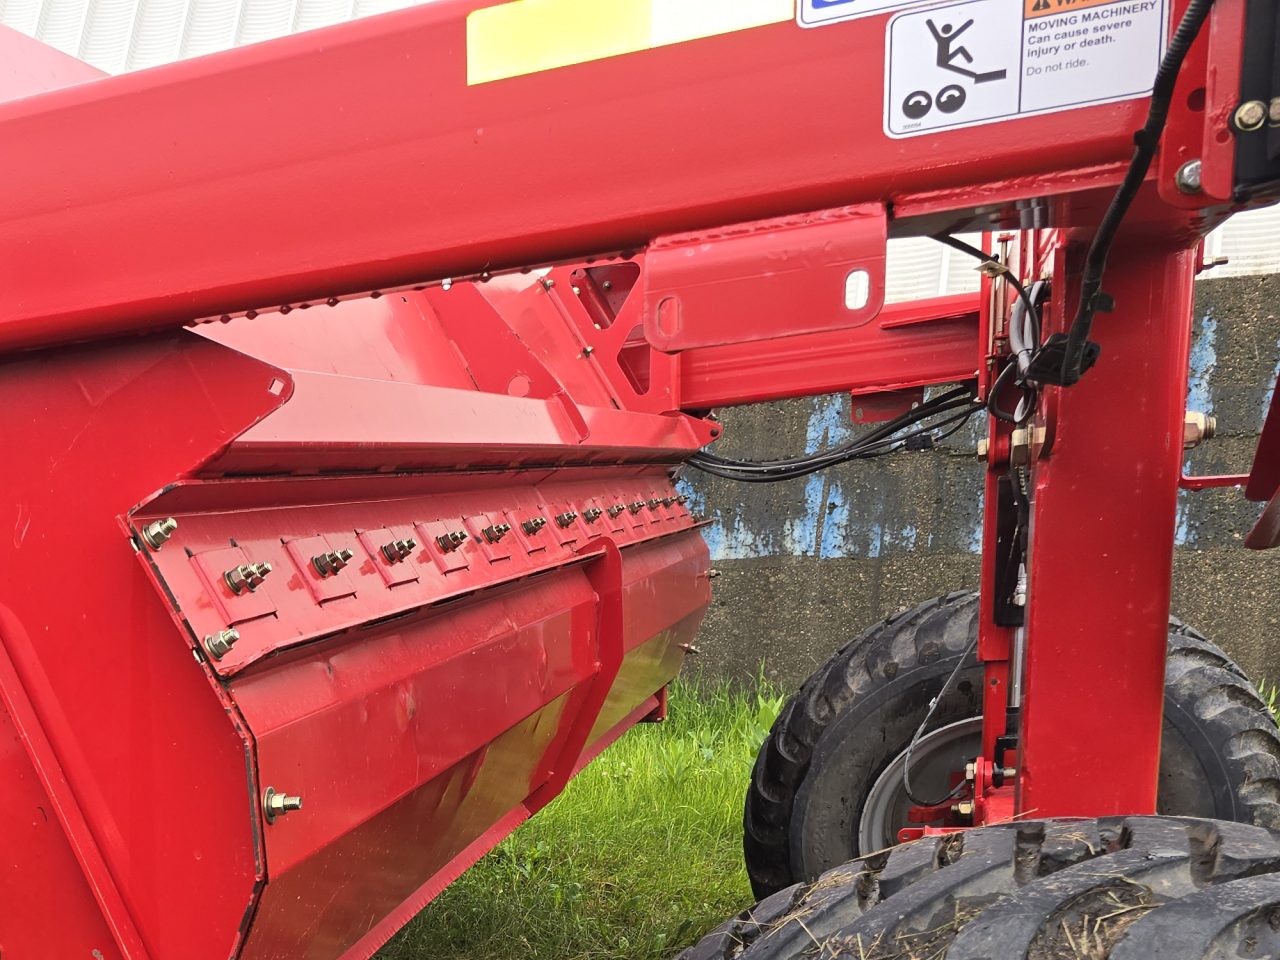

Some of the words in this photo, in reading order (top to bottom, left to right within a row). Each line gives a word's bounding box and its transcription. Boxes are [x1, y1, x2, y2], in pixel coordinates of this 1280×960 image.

[1028, 15, 1078, 33] MOVING
[1081, 0, 1157, 24] MACHINERY
[1027, 33, 1051, 46] Can
[1053, 27, 1089, 41] cause
[1092, 19, 1132, 33] severe
[1027, 45, 1060, 59] injury
[1063, 41, 1076, 51] or
[1079, 34, 1116, 49] death.
[1026, 66, 1041, 76] Do
[1045, 62, 1062, 73] not
[1065, 57, 1089, 70] ride.
